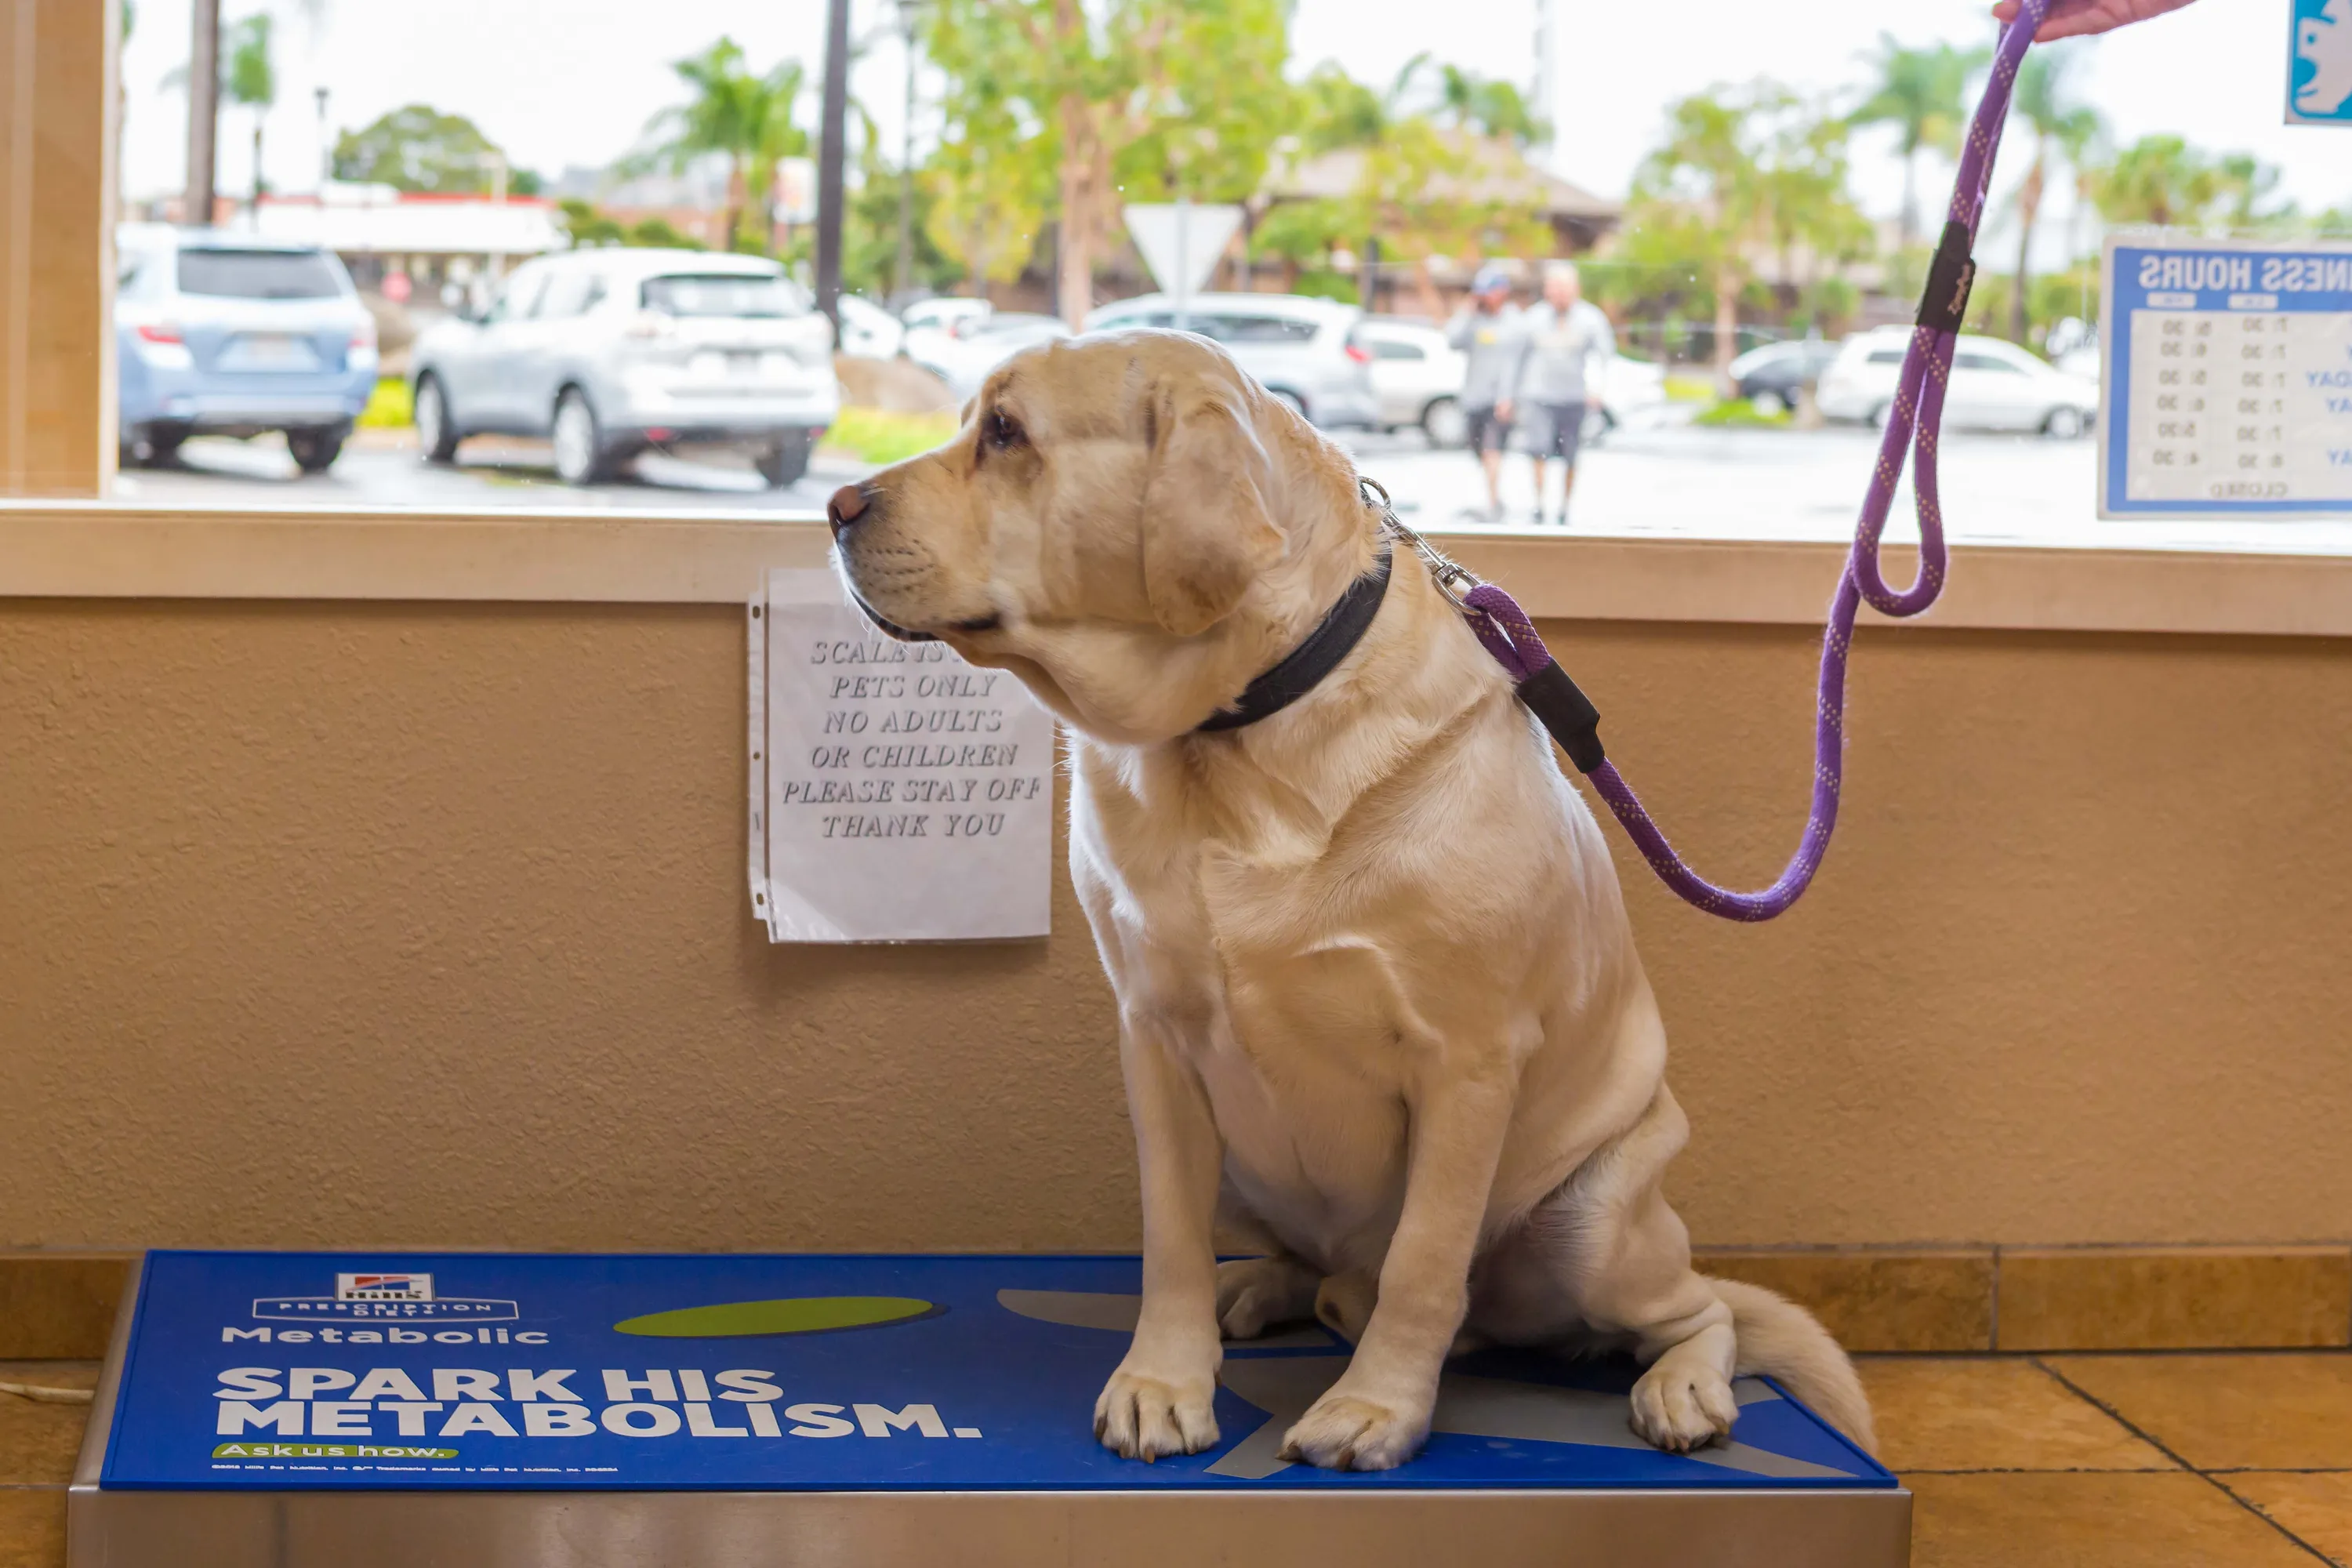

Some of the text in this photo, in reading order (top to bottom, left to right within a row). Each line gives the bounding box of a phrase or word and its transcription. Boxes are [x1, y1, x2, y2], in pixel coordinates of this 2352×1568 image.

[811, 641, 908, 664] SCALE
[829, 675, 998, 699] PETS ONLY
[823, 710, 1004, 734] NO ADULTS
[811, 744, 1018, 768] OR CHILDREN
[783, 777, 1040, 804] PLEASE STAY OFF
[822, 814, 1006, 838] THANK YOU
[222, 1327, 549, 1344] Metabolic
[212, 1367, 783, 1402] SPARK HIS
[216, 1401, 982, 1438] METABOLISM.
[220, 1444, 445, 1457] Ask us how.
